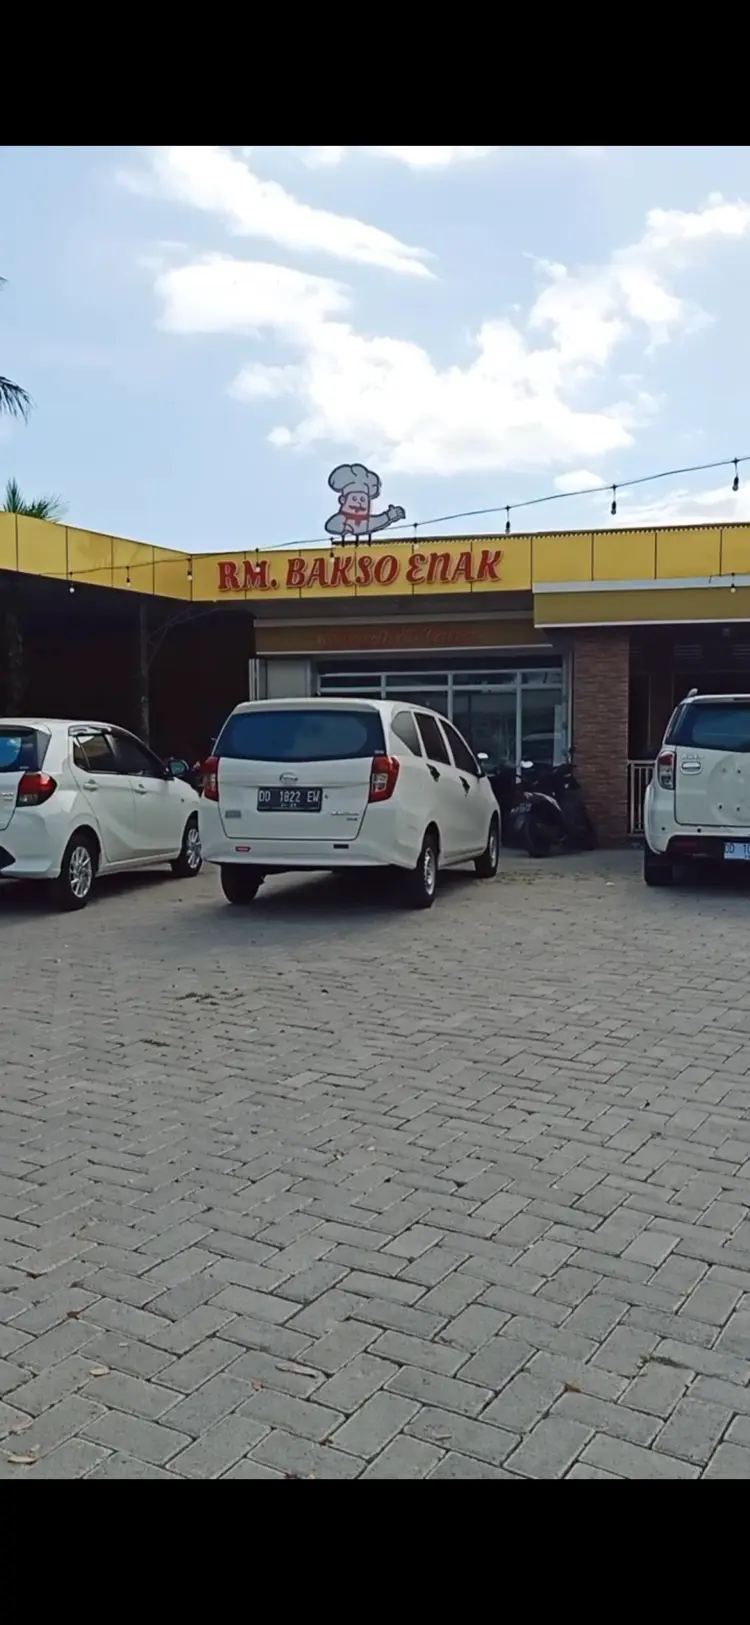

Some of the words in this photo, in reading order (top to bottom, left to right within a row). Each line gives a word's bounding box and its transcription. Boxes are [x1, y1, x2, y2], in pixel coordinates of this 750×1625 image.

[217, 559, 278, 592] RM.
[286, 552, 401, 589] BAKSO
[405, 549, 503, 585] ENAK
[258, 791, 271, 802] DD
[280, 791, 301, 803] 1822
[307, 791, 321, 802] EW
